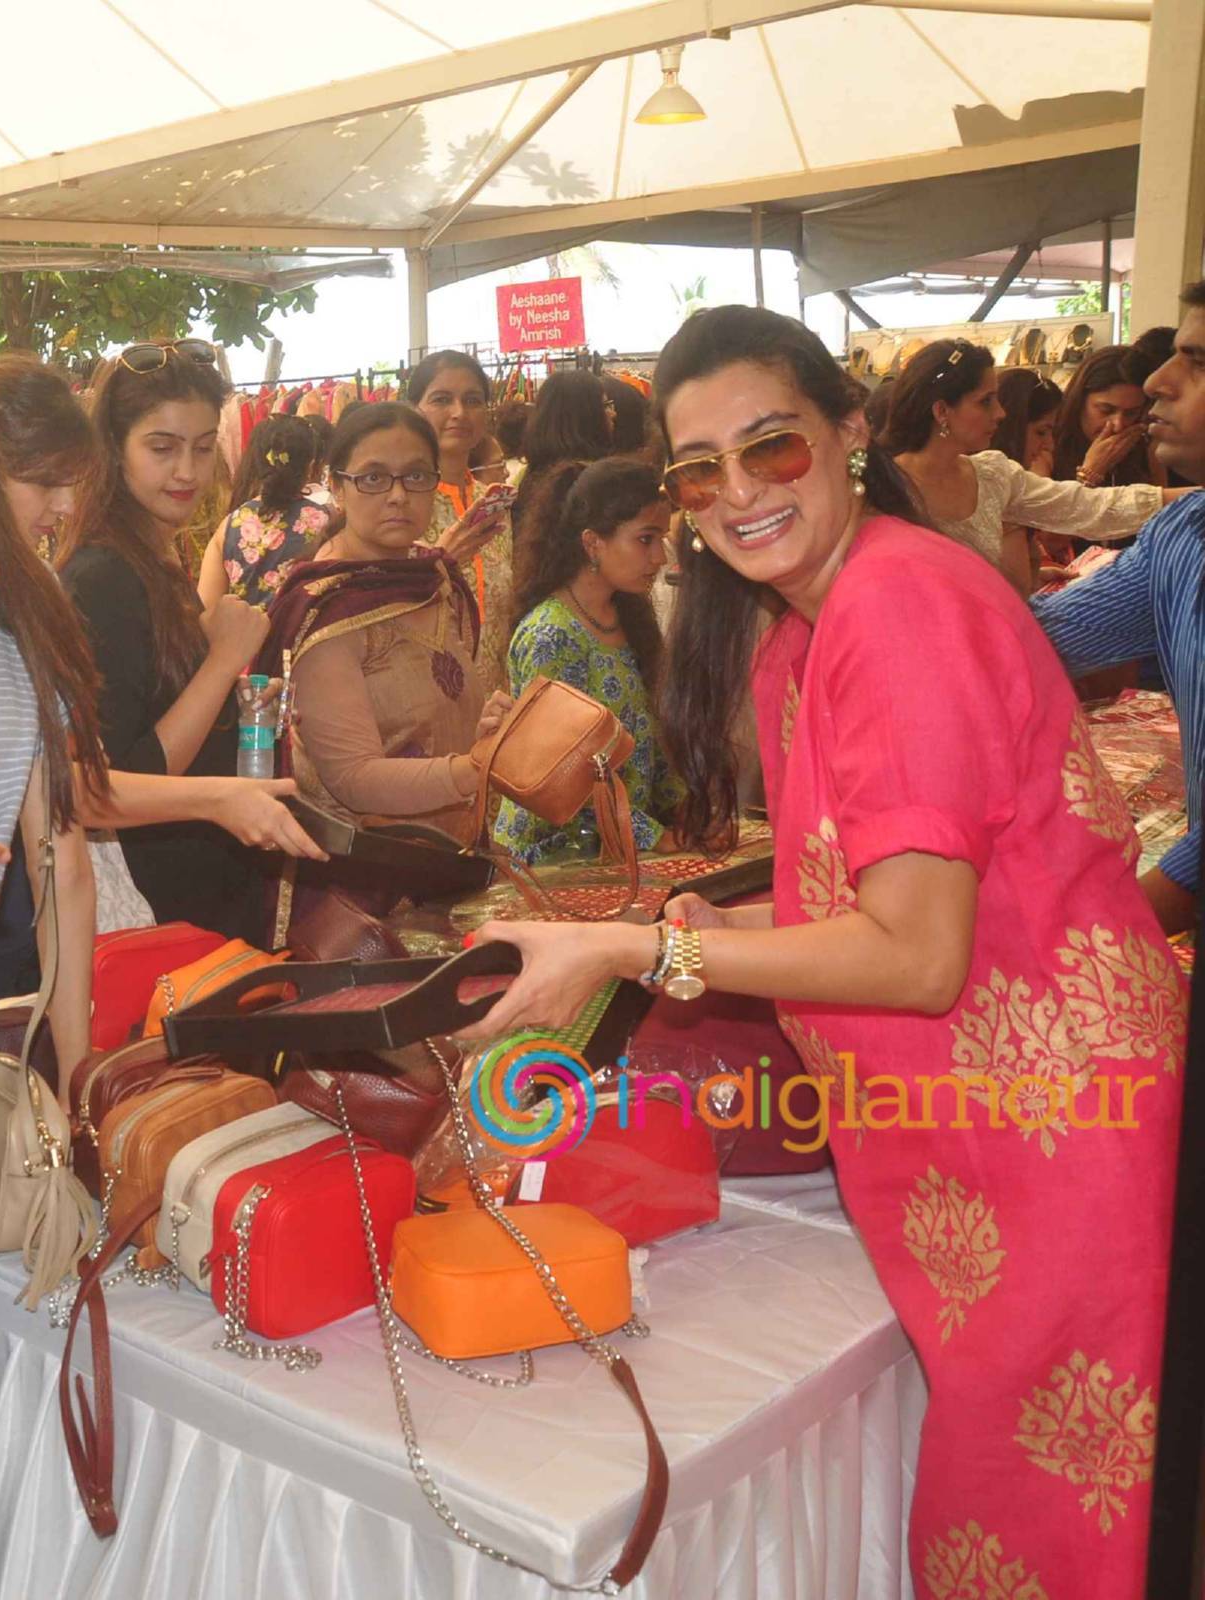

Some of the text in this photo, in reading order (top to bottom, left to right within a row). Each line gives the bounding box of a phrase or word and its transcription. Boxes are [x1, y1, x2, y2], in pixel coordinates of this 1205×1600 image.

[510, 292, 566, 308] Aeshaane
[508, 307, 570, 329] by Neesha
[520, 325, 562, 342] Amrish
